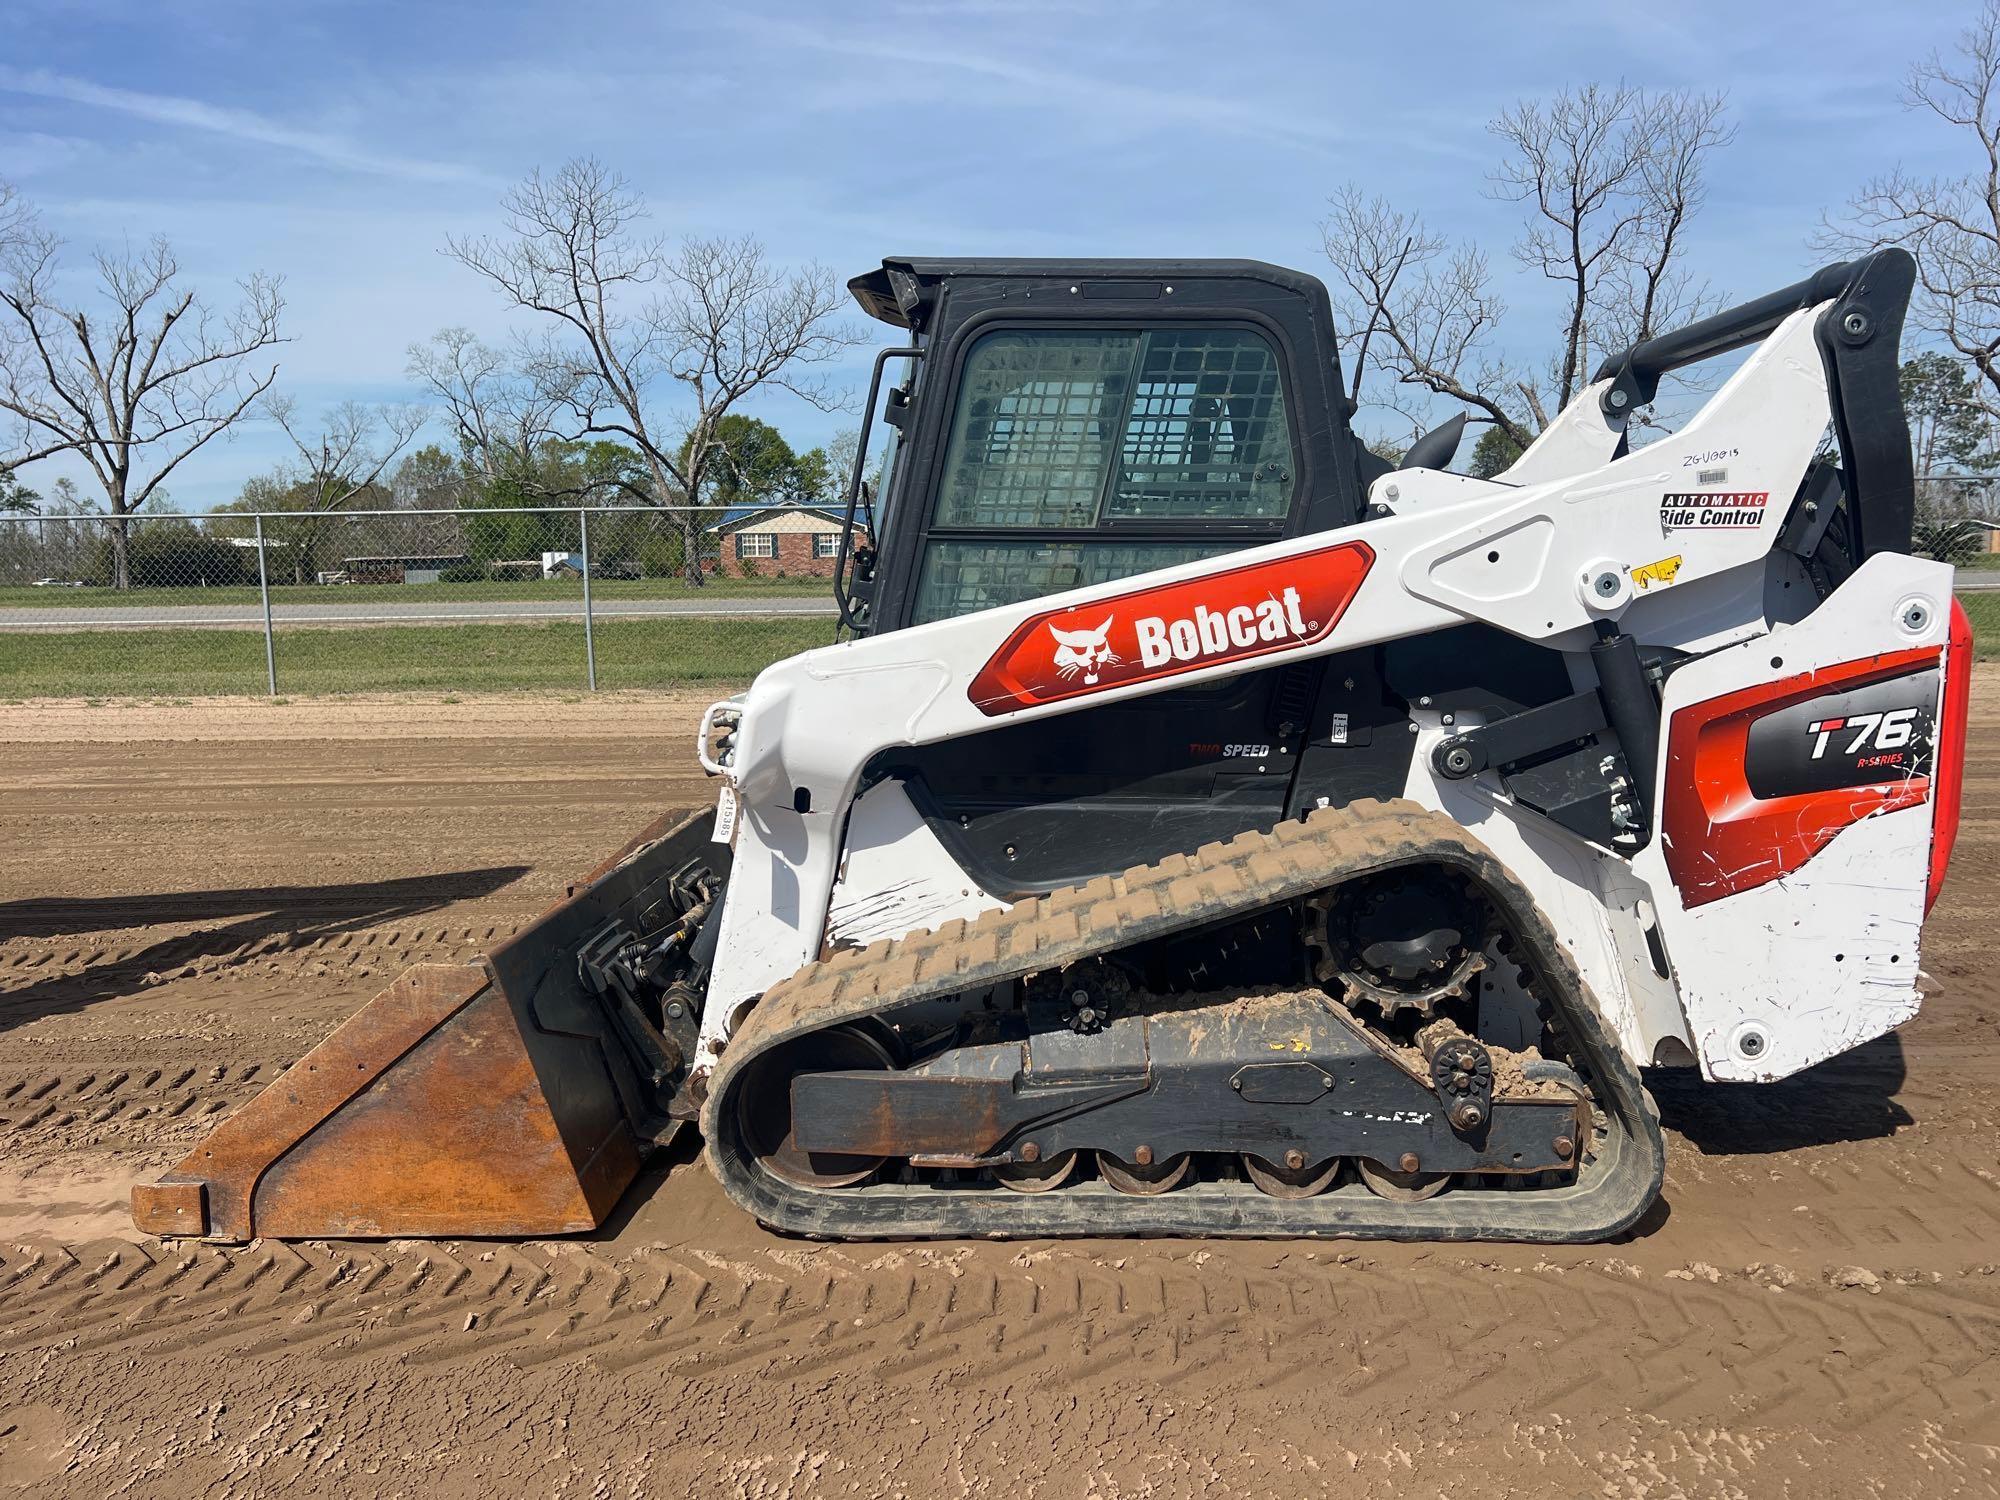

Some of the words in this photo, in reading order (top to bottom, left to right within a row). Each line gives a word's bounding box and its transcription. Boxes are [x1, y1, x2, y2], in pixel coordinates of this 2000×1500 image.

[1665, 495, 1764, 506] AUTOMATIC
[1660, 509, 1695, 525] Ride
[1700, 509, 1765, 525] Control
[1135, 586, 1308, 669] Bobcat
[1808, 708, 1918, 760] T76
[1222, 744, 1270, 757] SPEED
[720, 798, 735, 836] 215385
